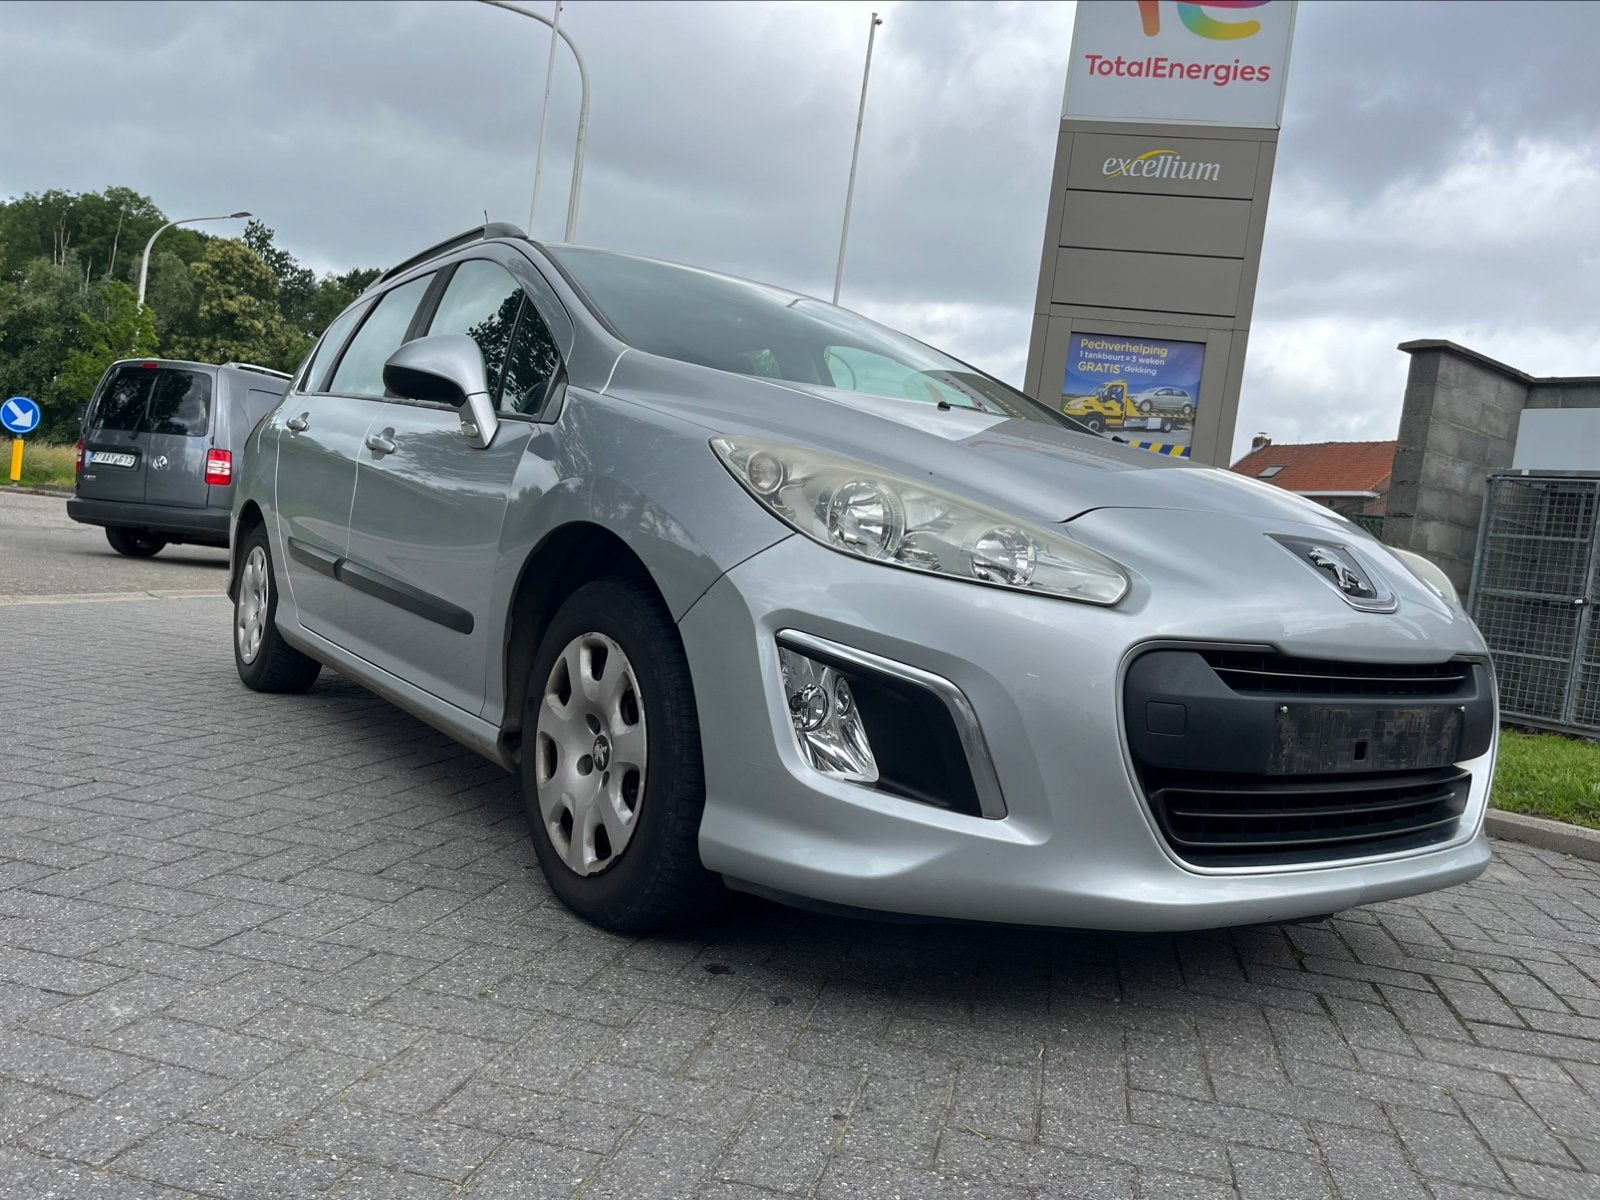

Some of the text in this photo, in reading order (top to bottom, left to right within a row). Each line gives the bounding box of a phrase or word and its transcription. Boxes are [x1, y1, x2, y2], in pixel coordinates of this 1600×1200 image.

[1085, 54, 1271, 86] TotalEnergies
[1102, 153, 1221, 181] excellium
[1080, 338, 1168, 358] Pechverhelping
[1085, 351, 1124, 362] tankbeurt
[1131, 355, 1137, 363] 3
[1138, 357, 1165, 366] weken
[1124, 365, 1157, 376] dekking
